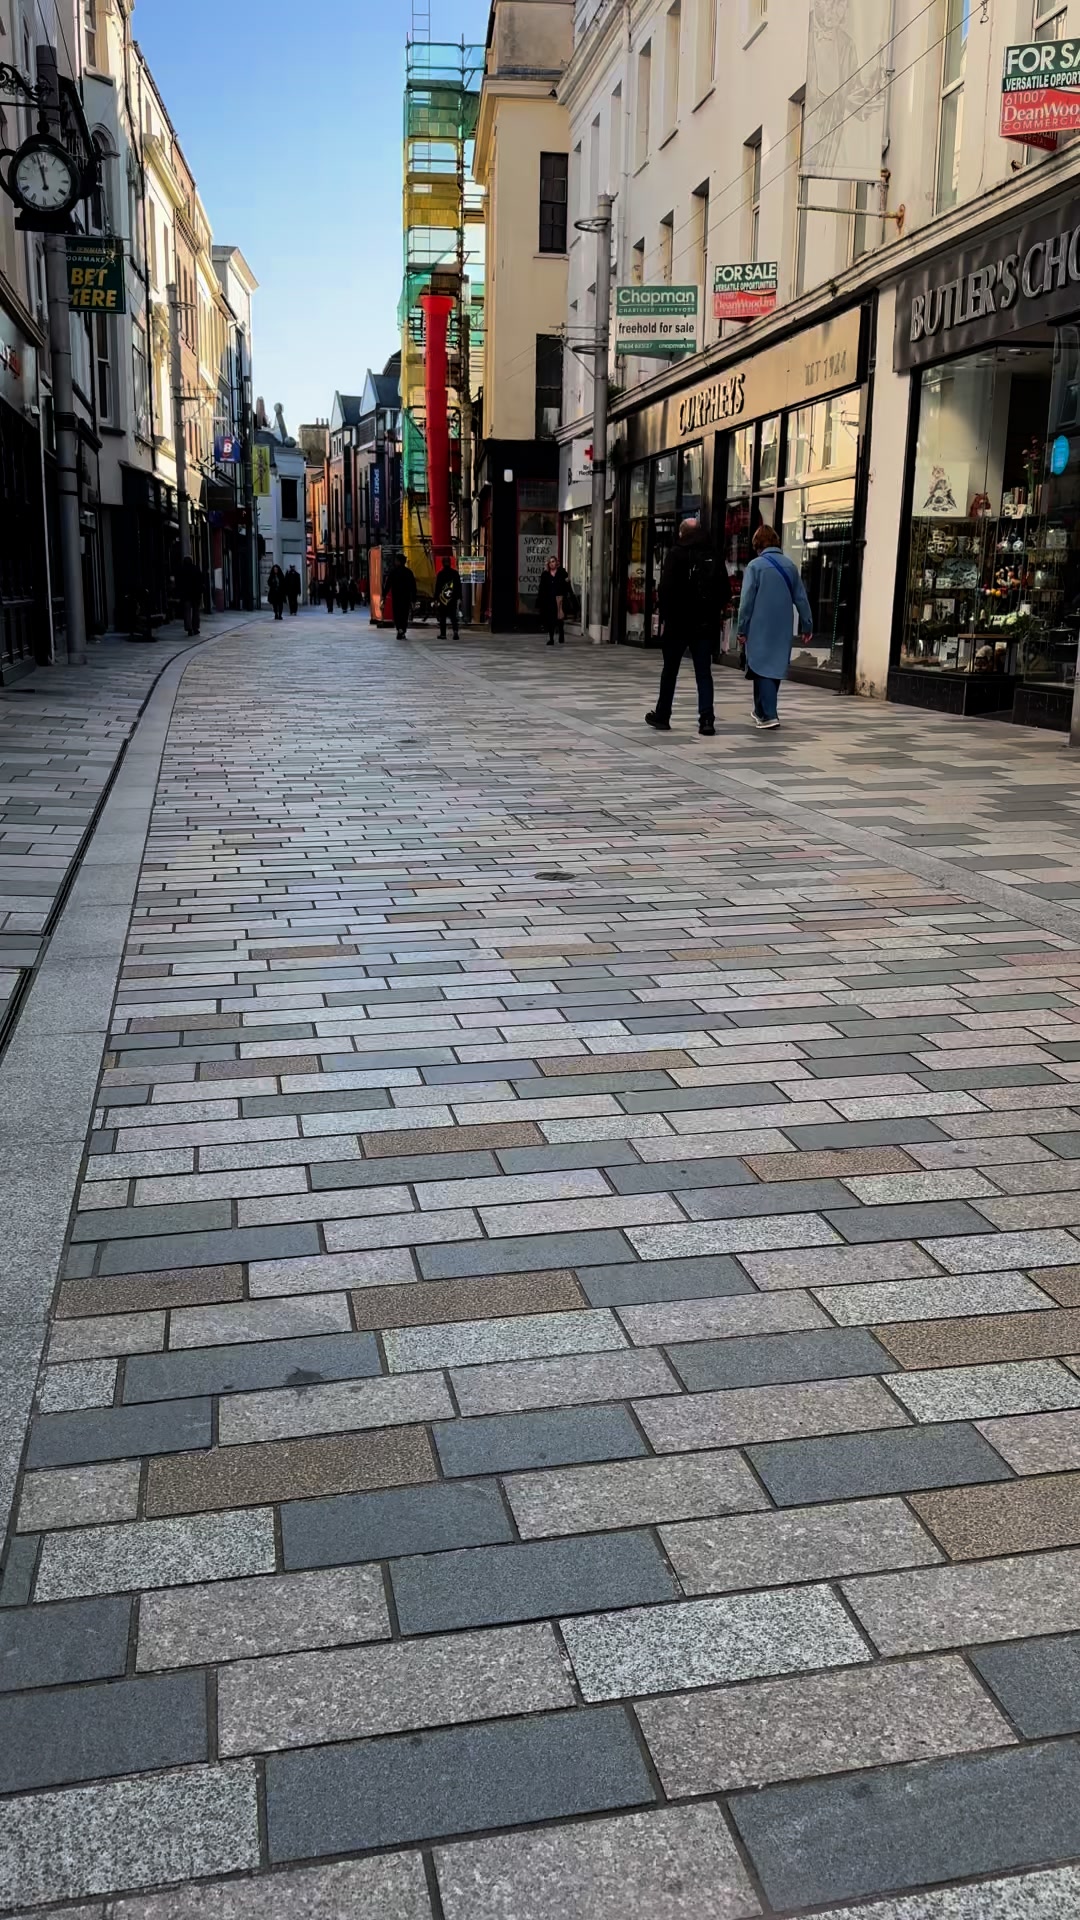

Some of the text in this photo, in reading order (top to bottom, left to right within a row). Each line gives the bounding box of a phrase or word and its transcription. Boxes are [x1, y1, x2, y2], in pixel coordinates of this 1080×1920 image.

[1007, 46, 1055, 74] FOR
[1005, 91, 1046, 105] 611007
[71, 267, 108, 287] BET
[716, 263, 777, 282] FOR SALE
[619, 289, 695, 306] Chapman
[910, 254, 1018, 341] BUTLER'S
[618, 322, 694, 334] freehold for sale
[824, 349, 847, 381] 1924
[524, 537, 553, 545] SPORTS
[526, 546, 550, 554] BEERS
[526, 555, 545, 563] WINE
